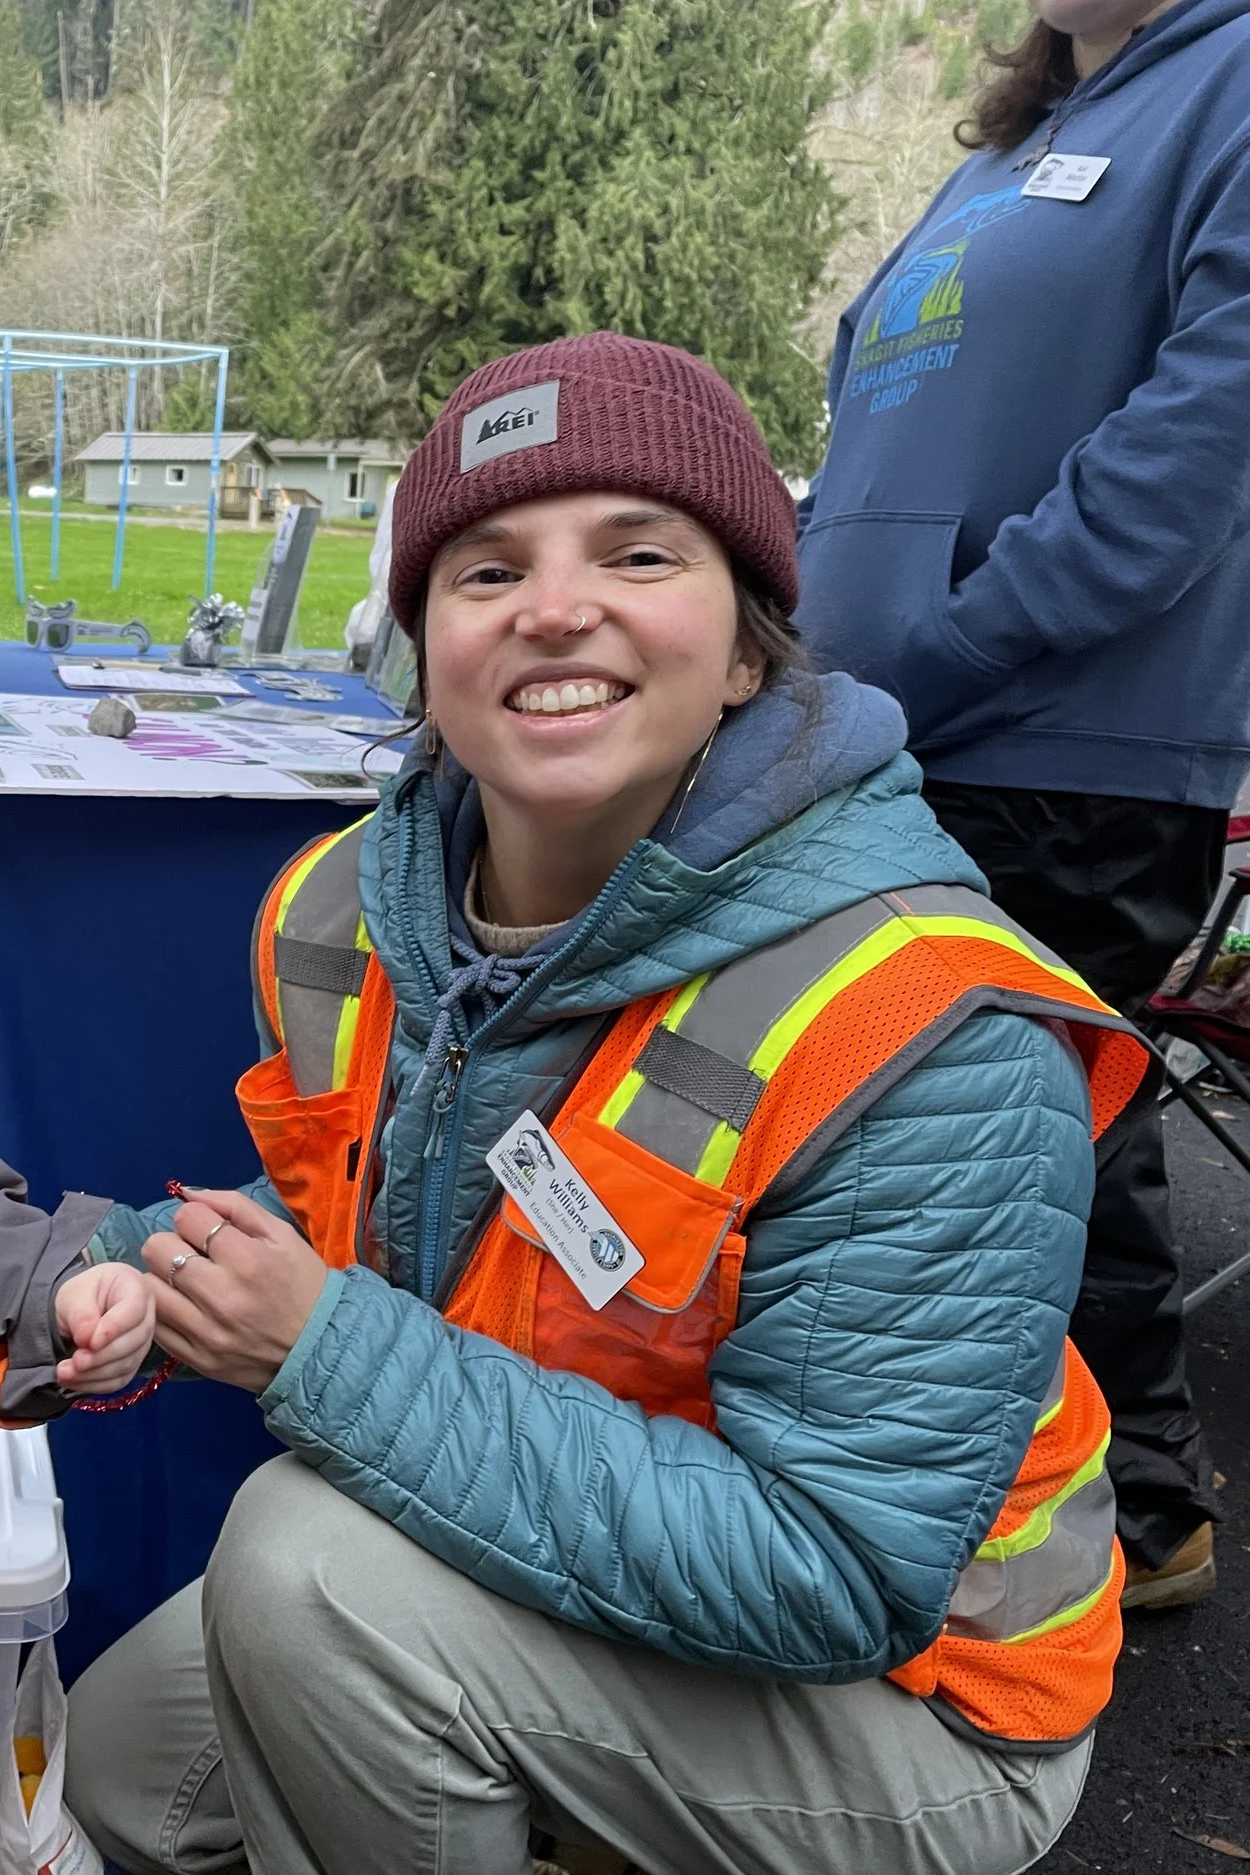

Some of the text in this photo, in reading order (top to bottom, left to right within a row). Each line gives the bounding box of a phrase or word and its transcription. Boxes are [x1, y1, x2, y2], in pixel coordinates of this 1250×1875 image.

[501, 1169, 518, 1190] GROUP
[564, 1178, 589, 1211] Kelly
[549, 1178, 589, 1233] Williams
[530, 1201, 587, 1280] Education Associate
